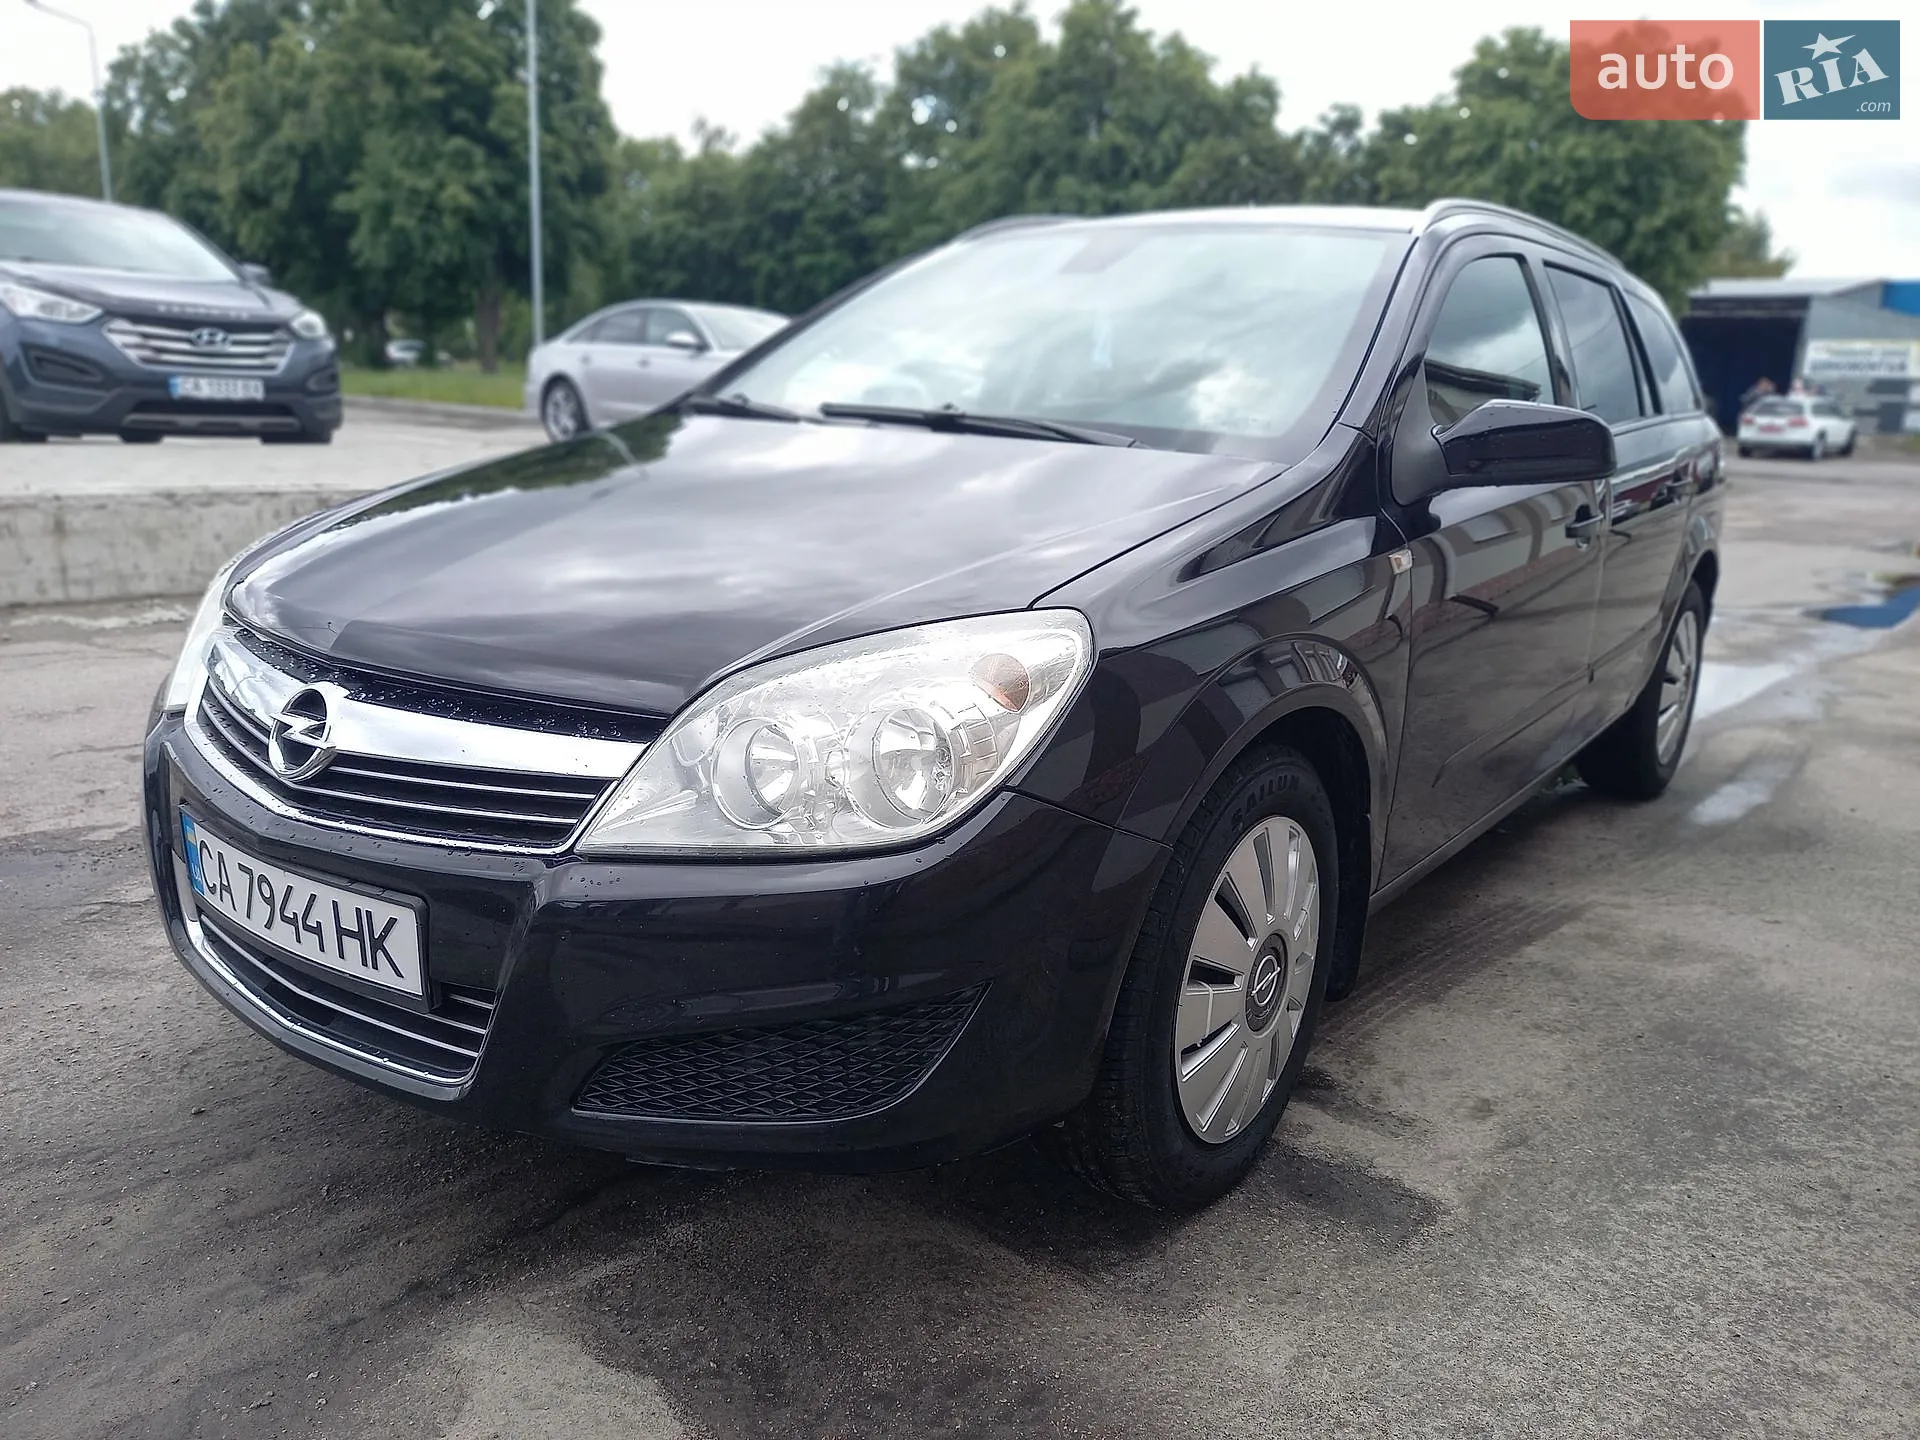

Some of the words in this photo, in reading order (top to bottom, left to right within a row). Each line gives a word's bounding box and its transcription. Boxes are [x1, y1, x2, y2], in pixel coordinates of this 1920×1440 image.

[199, 839, 237, 912] CA
[238, 862, 325, 953] 7944
[332, 899, 405, 979] HK
